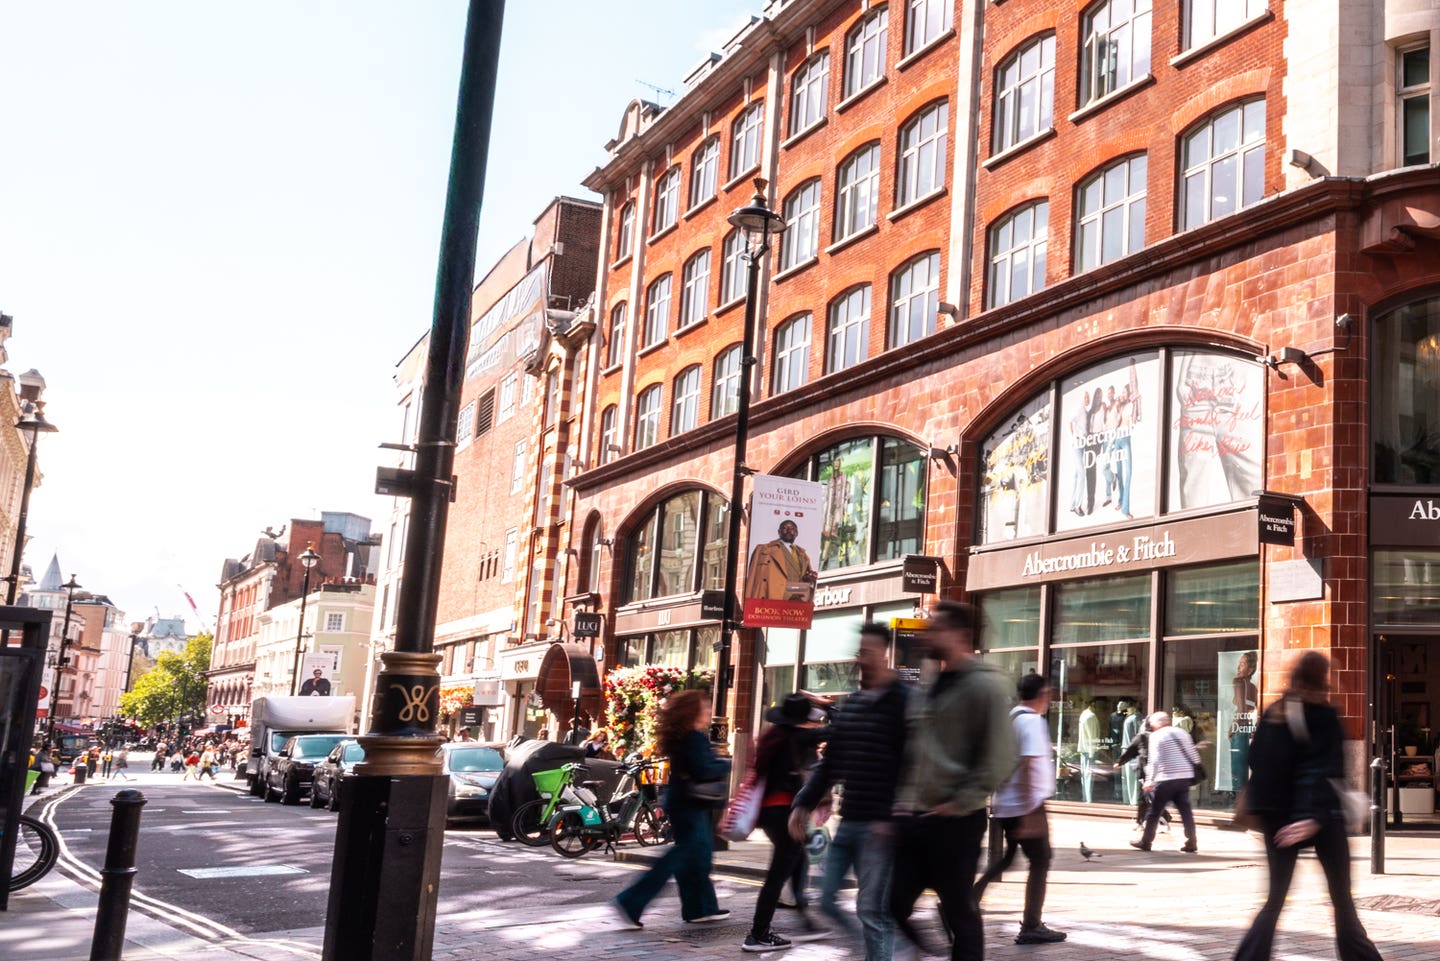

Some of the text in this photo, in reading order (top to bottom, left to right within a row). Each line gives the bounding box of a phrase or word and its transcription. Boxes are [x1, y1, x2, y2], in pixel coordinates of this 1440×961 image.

[1227, 401, 1261, 432] feel
[1070, 426, 1137, 448] bercrom
[760, 492, 784, 500] YOUR
[777, 488, 800, 496] GIRD
[1260, 514, 1294, 525] Abercrombie
[1273, 524, 1287, 533] Fitch
[1022, 531, 1176, 576] Abercrombie & Fitch
[815, 586, 851, 607] arbour
[754, 607, 805, 617] BOOK NOW
